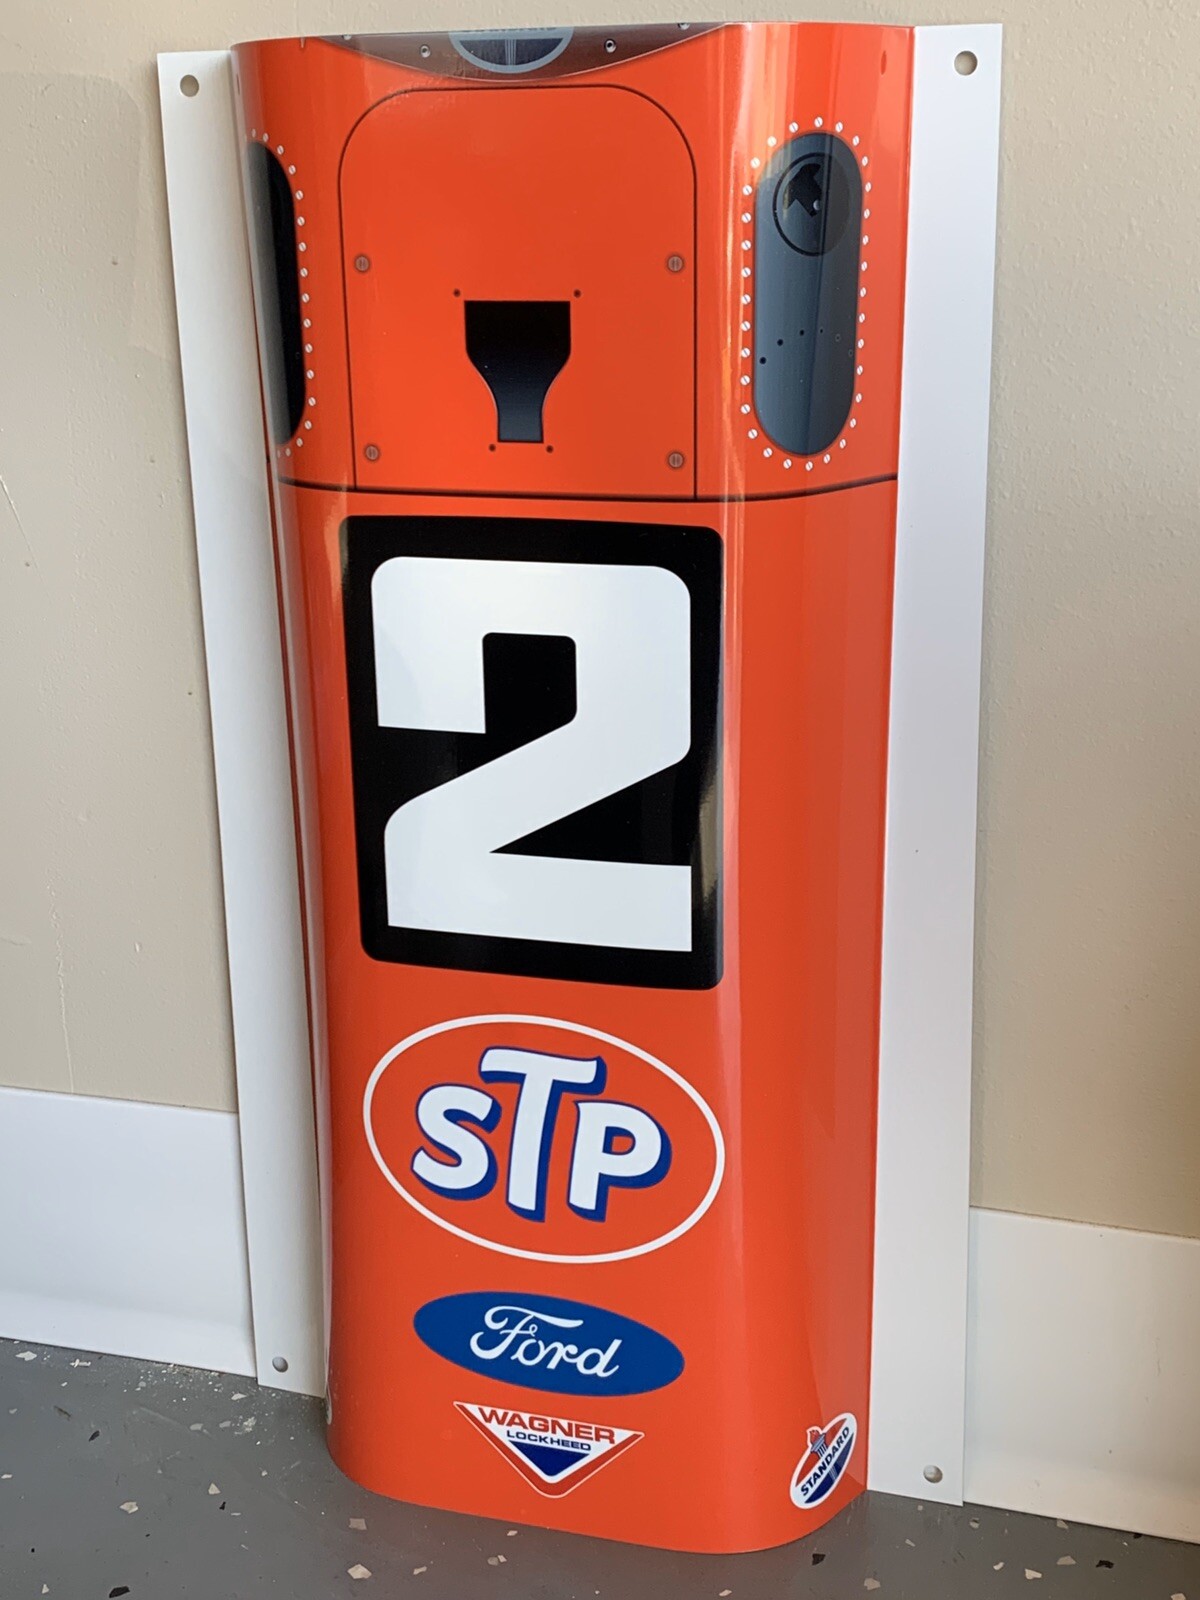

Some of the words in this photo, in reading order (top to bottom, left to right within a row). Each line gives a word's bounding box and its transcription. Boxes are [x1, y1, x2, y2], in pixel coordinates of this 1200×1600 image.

[369, 556, 693, 953] 2
[411, 1046, 672, 1223] STP
[469, 1305, 623, 1378] Ford
[477, 1406, 616, 1445] WAGNER
[506, 1430, 592, 1452] LOCKHEED
[800, 1426, 850, 1497] STANDARD
